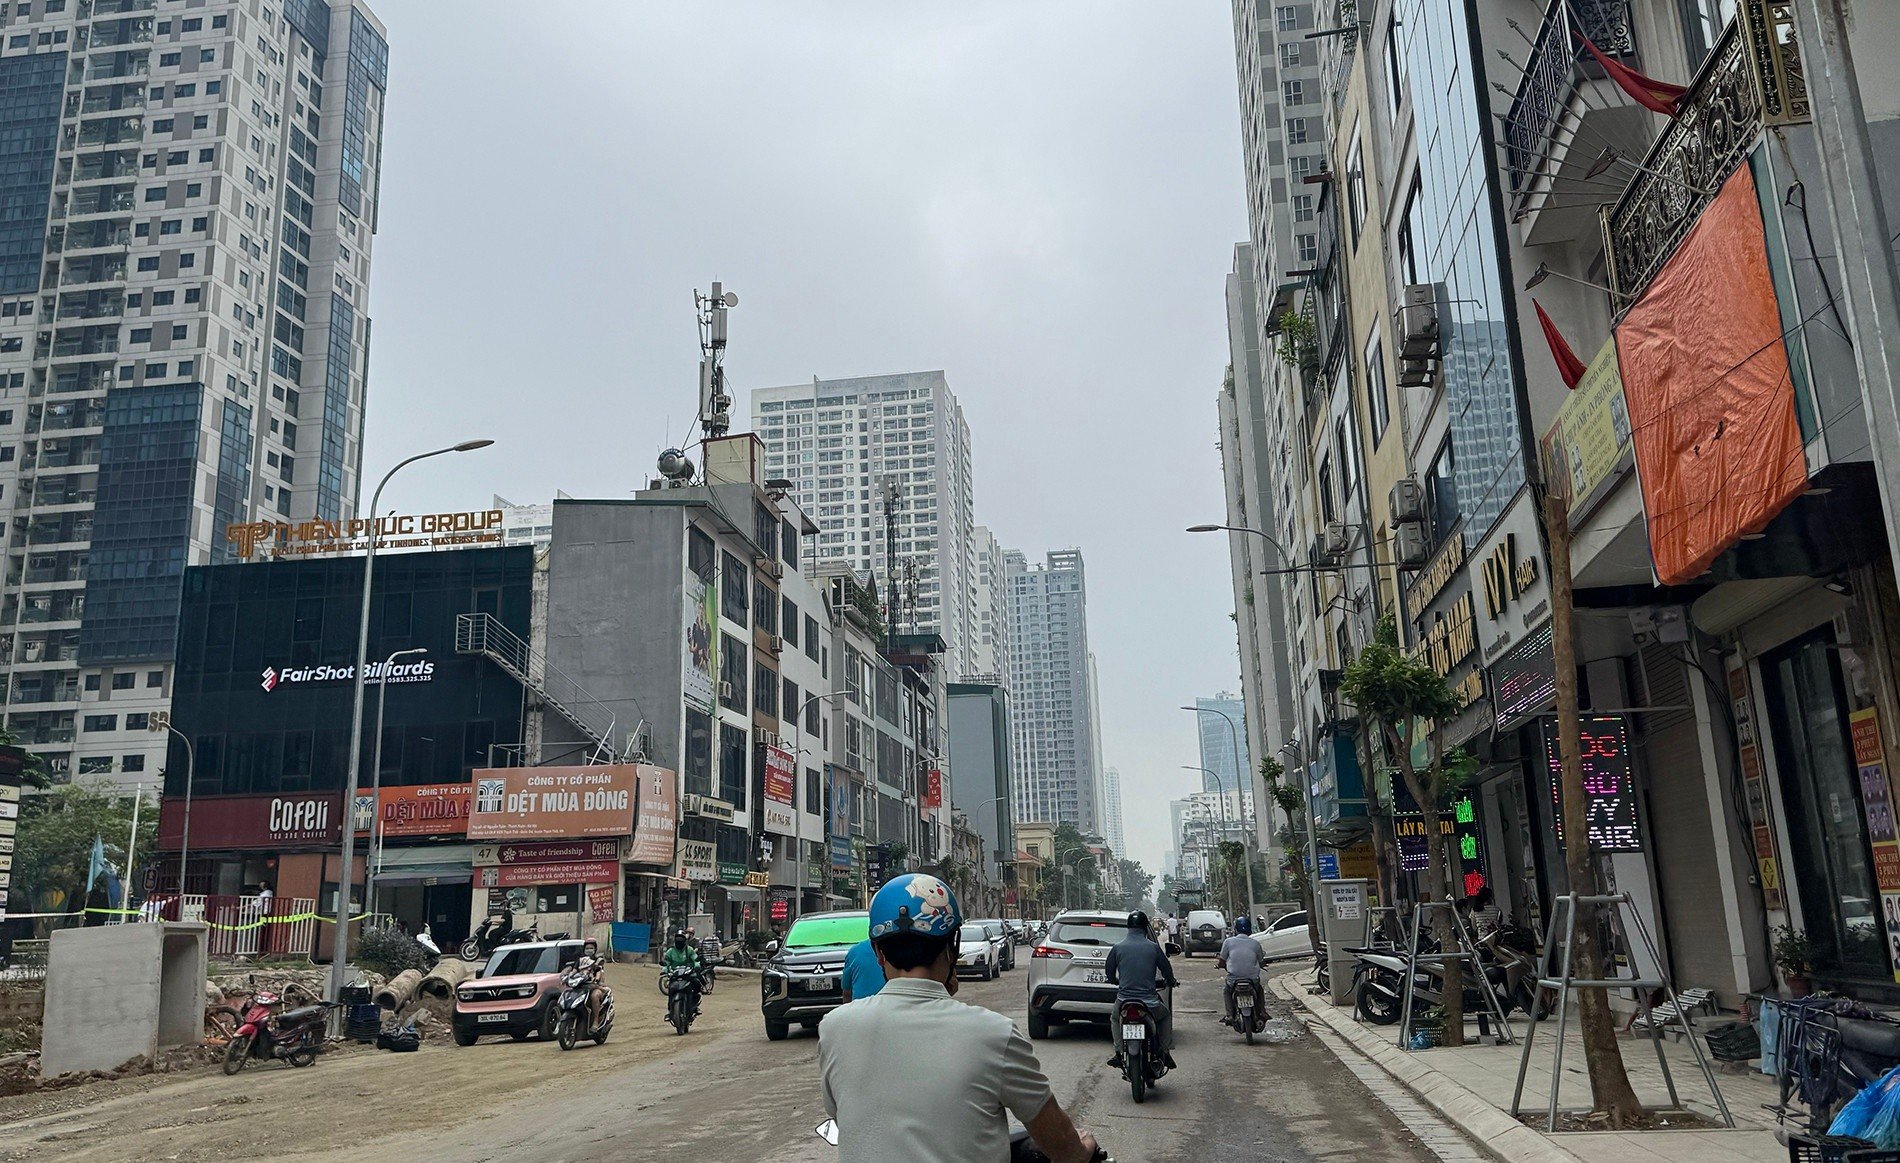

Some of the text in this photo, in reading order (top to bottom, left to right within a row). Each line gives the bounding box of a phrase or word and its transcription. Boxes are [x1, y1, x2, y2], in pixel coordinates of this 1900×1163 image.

[274, 510, 503, 542] THIÊN PHÚC GROUP
[1481, 533, 1515, 621] IVY
[1515, 556, 1538, 594] HAIR
[1447, 590, 1475, 668] NAM
[279, 665, 355, 682] FairShot
[417, 787, 438, 796] CÔNG
[527, 775, 554, 786] CÔNG
[556, 776, 568, 785] TY
[270, 798, 328, 832] Cofeli
[384, 797, 417, 825] DỆT
[420, 796, 459, 819] MÙA
[507, 787, 629, 817] DỆT MÙA ĐÔNG
[1397, 818, 1415, 836] LẤY
[478, 848, 492, 859] 47
[547, 848, 584, 856] friendship
